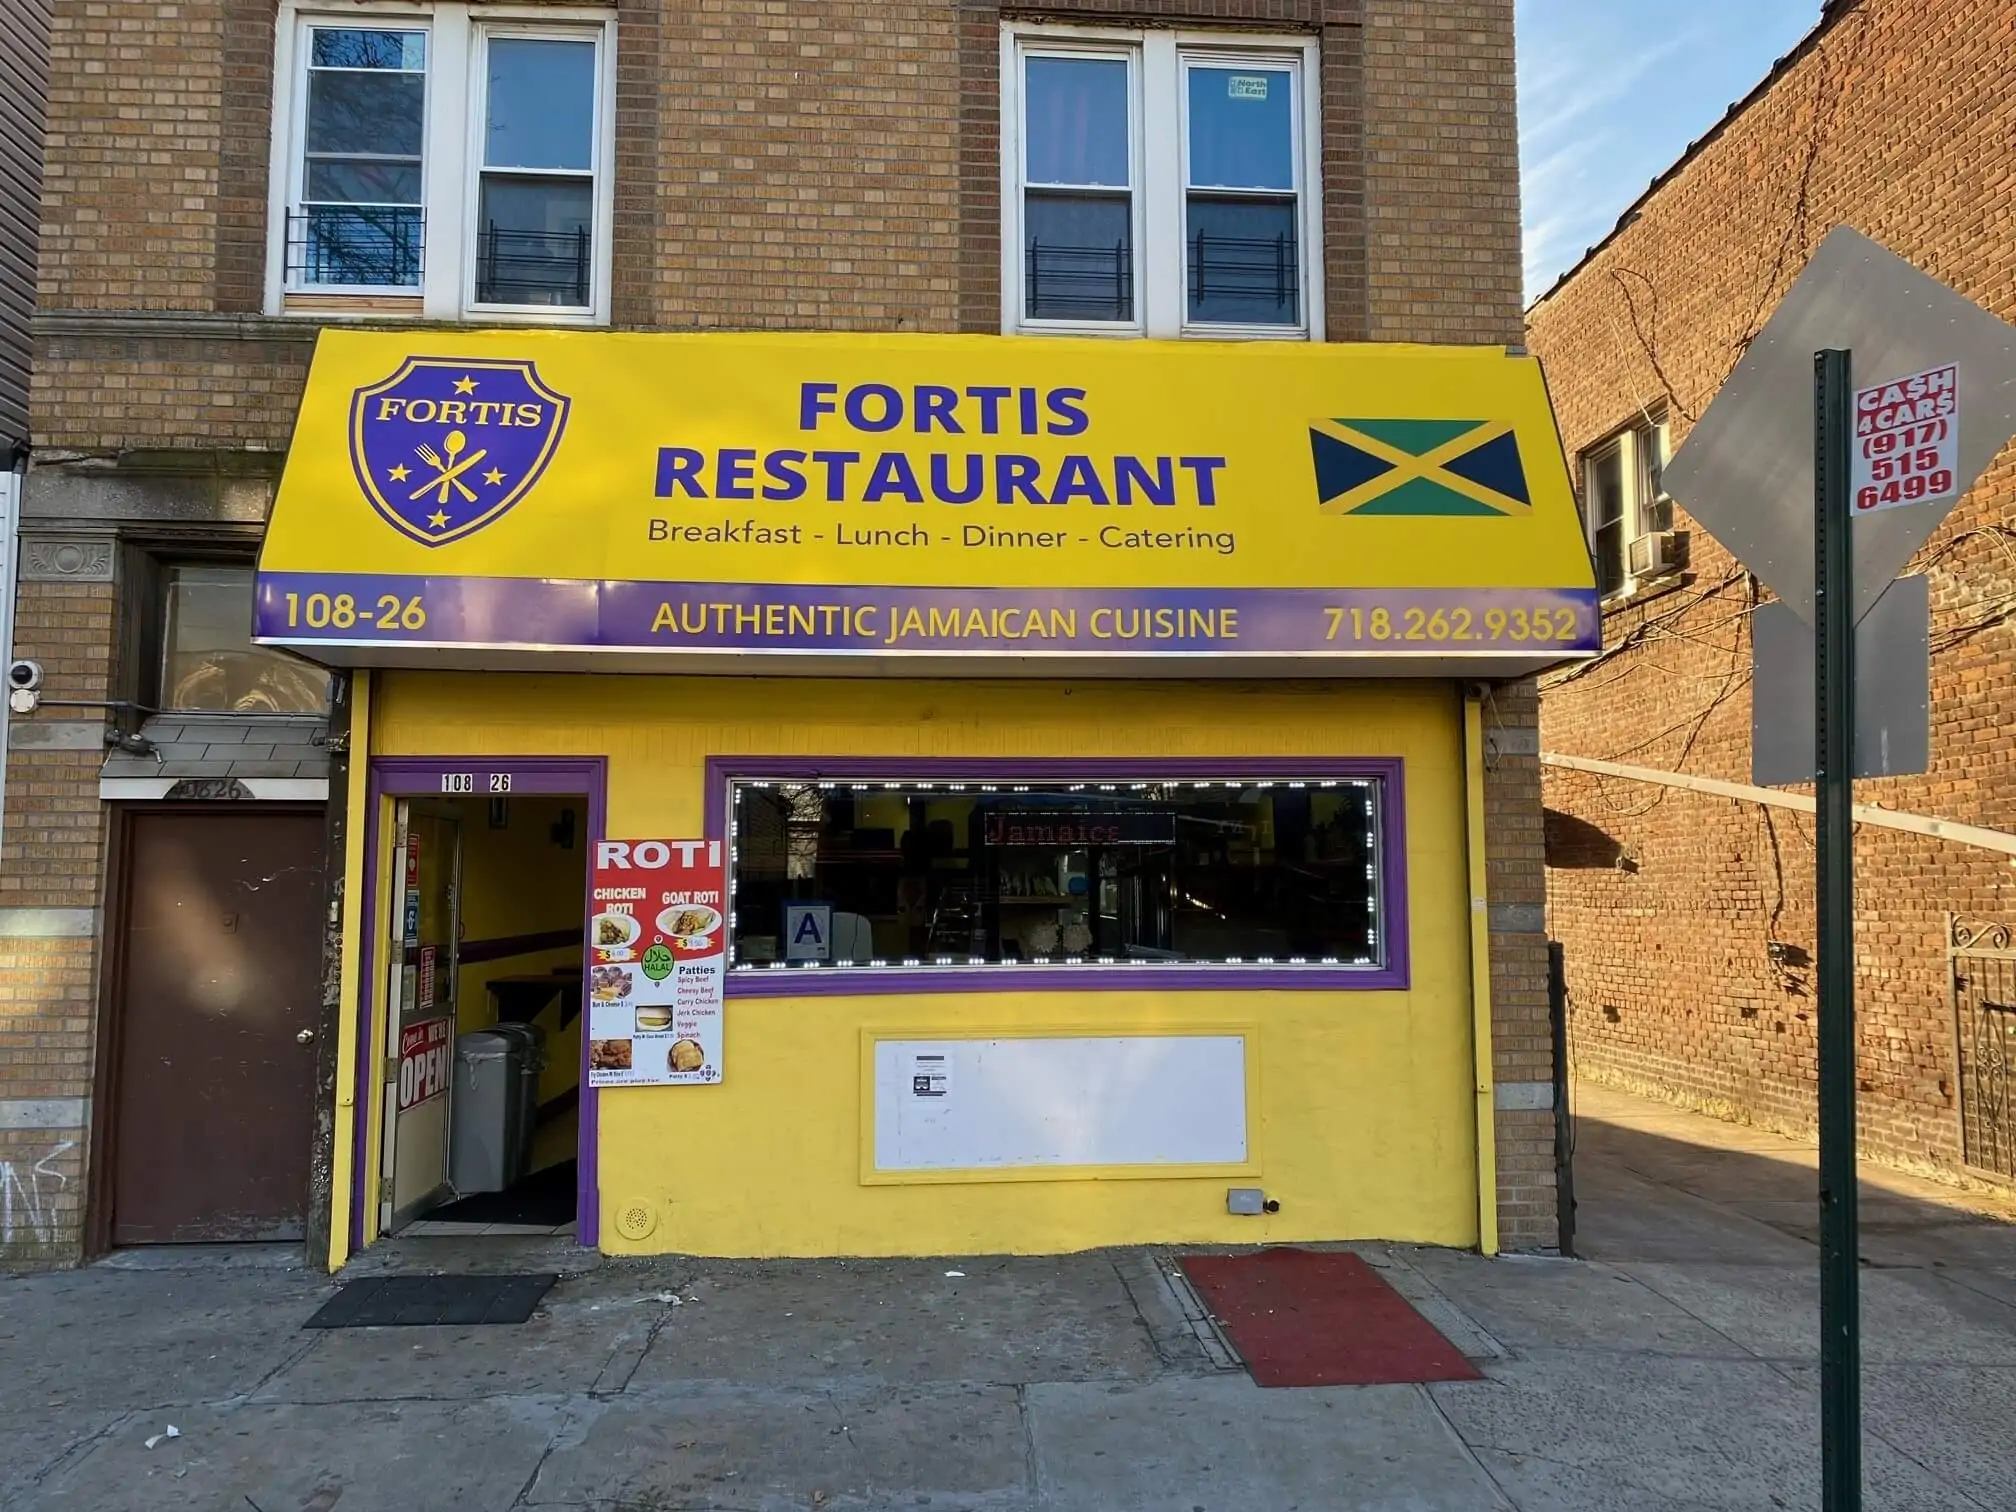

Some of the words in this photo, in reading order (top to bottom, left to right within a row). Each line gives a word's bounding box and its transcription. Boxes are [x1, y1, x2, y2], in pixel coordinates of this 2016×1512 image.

[376, 397, 542, 427] FORTIS
[800, 382, 1090, 436] FORTIS
[1858, 415, 1873, 434] 4
[1862, 418, 1948, 459] (917)
[1871, 445, 1939, 482] 515
[654, 446, 1227, 507] RESTAURANT
[1857, 469, 1952, 510] 6499
[648, 518, 802, 545] Breakfast
[836, 522, 930, 547] Lunch
[963, 524, 1066, 549] Dinner
[1099, 526, 1236, 555] Catering
[285, 592, 427, 630] 108-26
[651, 601, 877, 636] AUTHENTIC
[885, 605, 1076, 644] JAMAICAN
[1089, 608, 1239, 639] CUISINE
[1323, 606, 1578, 641] 718.262.9352
[444, 774, 472, 792] 108
[490, 774, 510, 792] 26
[597, 840, 721, 869] ROTI
[594, 887, 646, 900] CHICKEN
[662, 890, 692, 904] GOAT
[693, 890, 719, 904] ROTI
[606, 902, 634, 915] ROTI
[793, 911, 823, 944] A
[644, 963, 670, 972] HALAL
[645, 948, 671, 963] حلال
[677, 976, 694, 984] Spicy
[695, 975, 709, 983] Beef
[679, 966, 716, 975] Patties
[677, 999, 694, 1007] Curry
[695, 998, 719, 1006] Chicken
[700, 986, 715, 995] Beef
[677, 1009, 690, 1017] Jerk
[691, 1009, 716, 1017] Chicken
[677, 1031, 701, 1040] Spinach
[400, 1044, 447, 1107] OPEN
